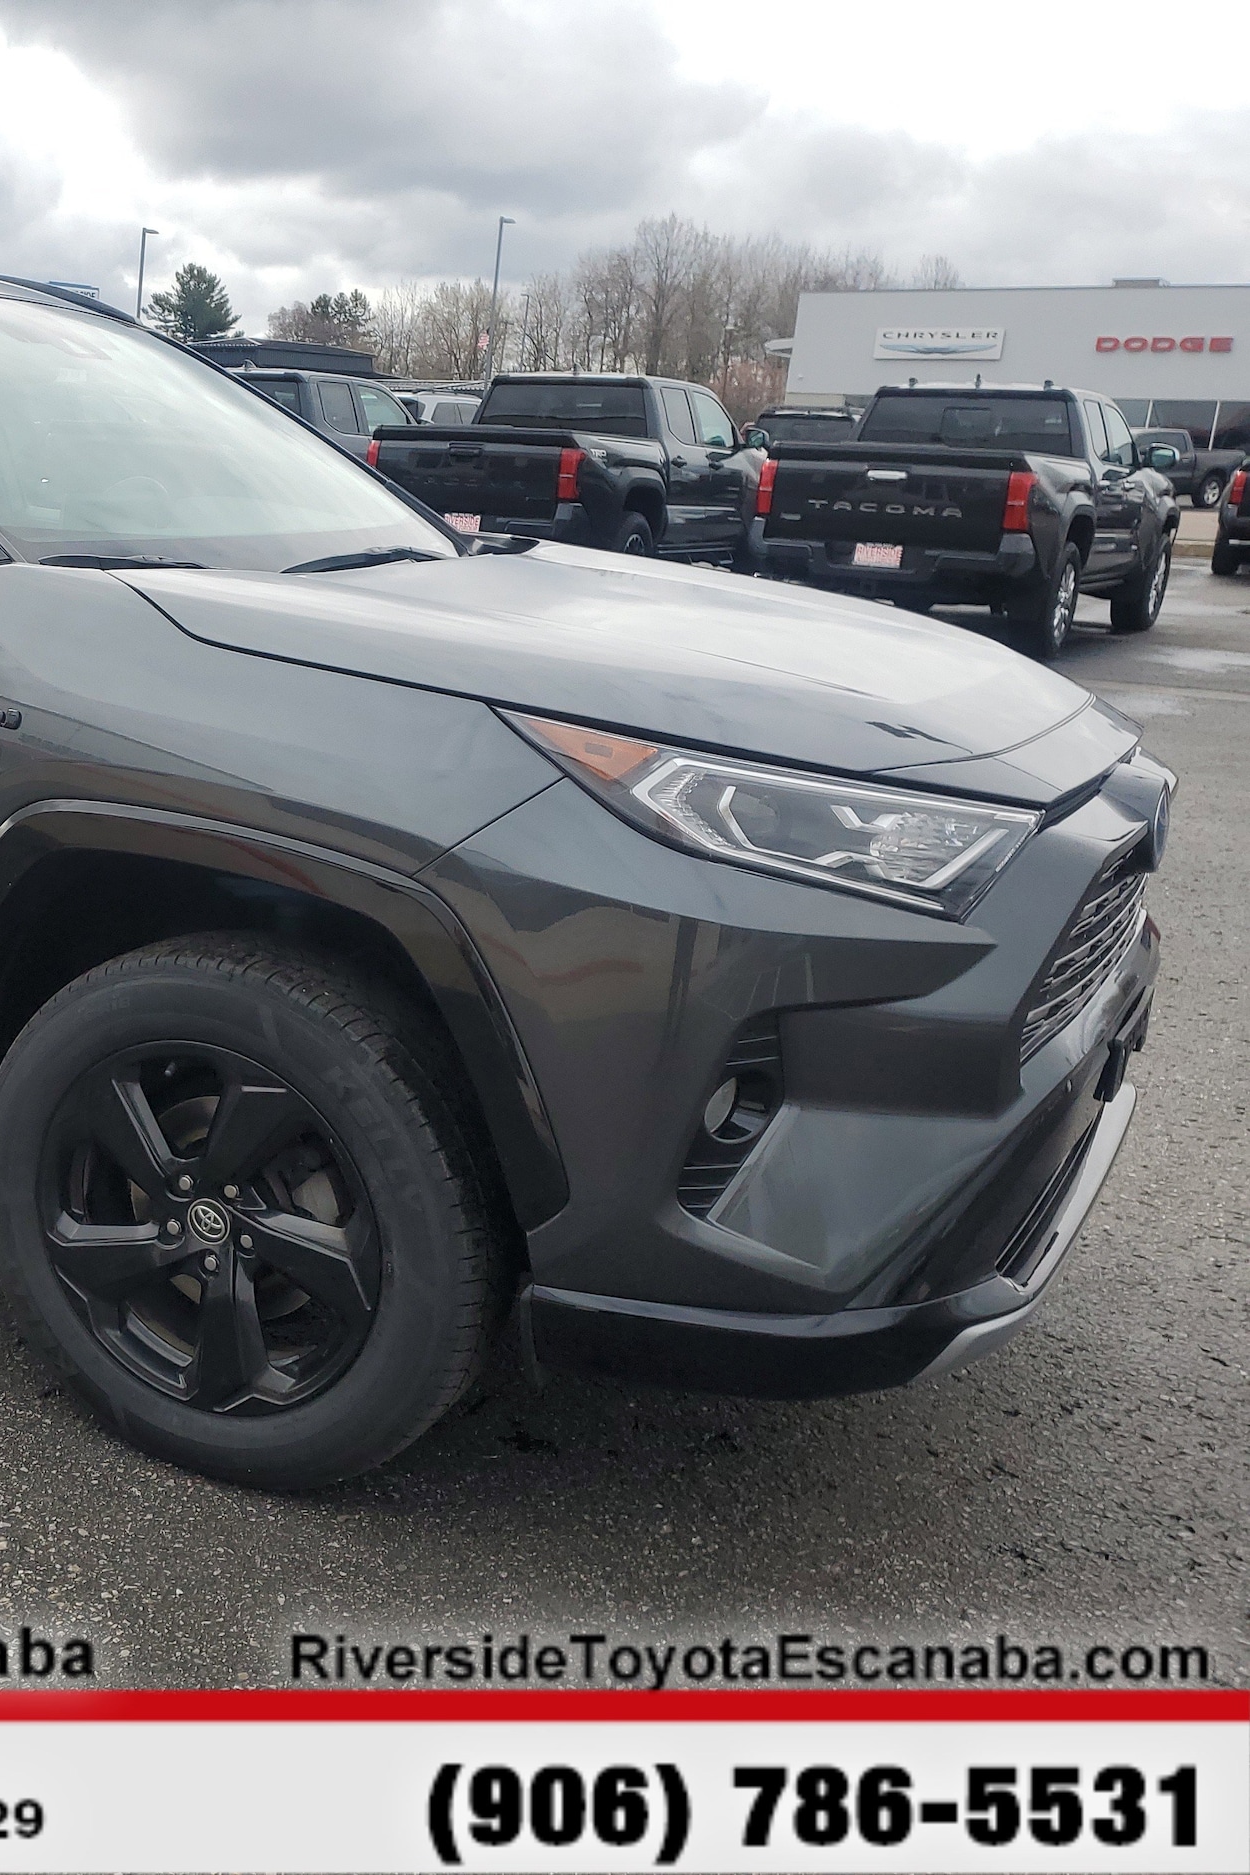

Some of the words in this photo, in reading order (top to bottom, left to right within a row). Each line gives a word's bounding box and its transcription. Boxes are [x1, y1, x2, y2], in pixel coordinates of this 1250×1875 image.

[882, 331, 998, 340] CHRYSLER
[1096, 336, 1234, 353] DODGE
[808, 499, 963, 518] TACOMA
